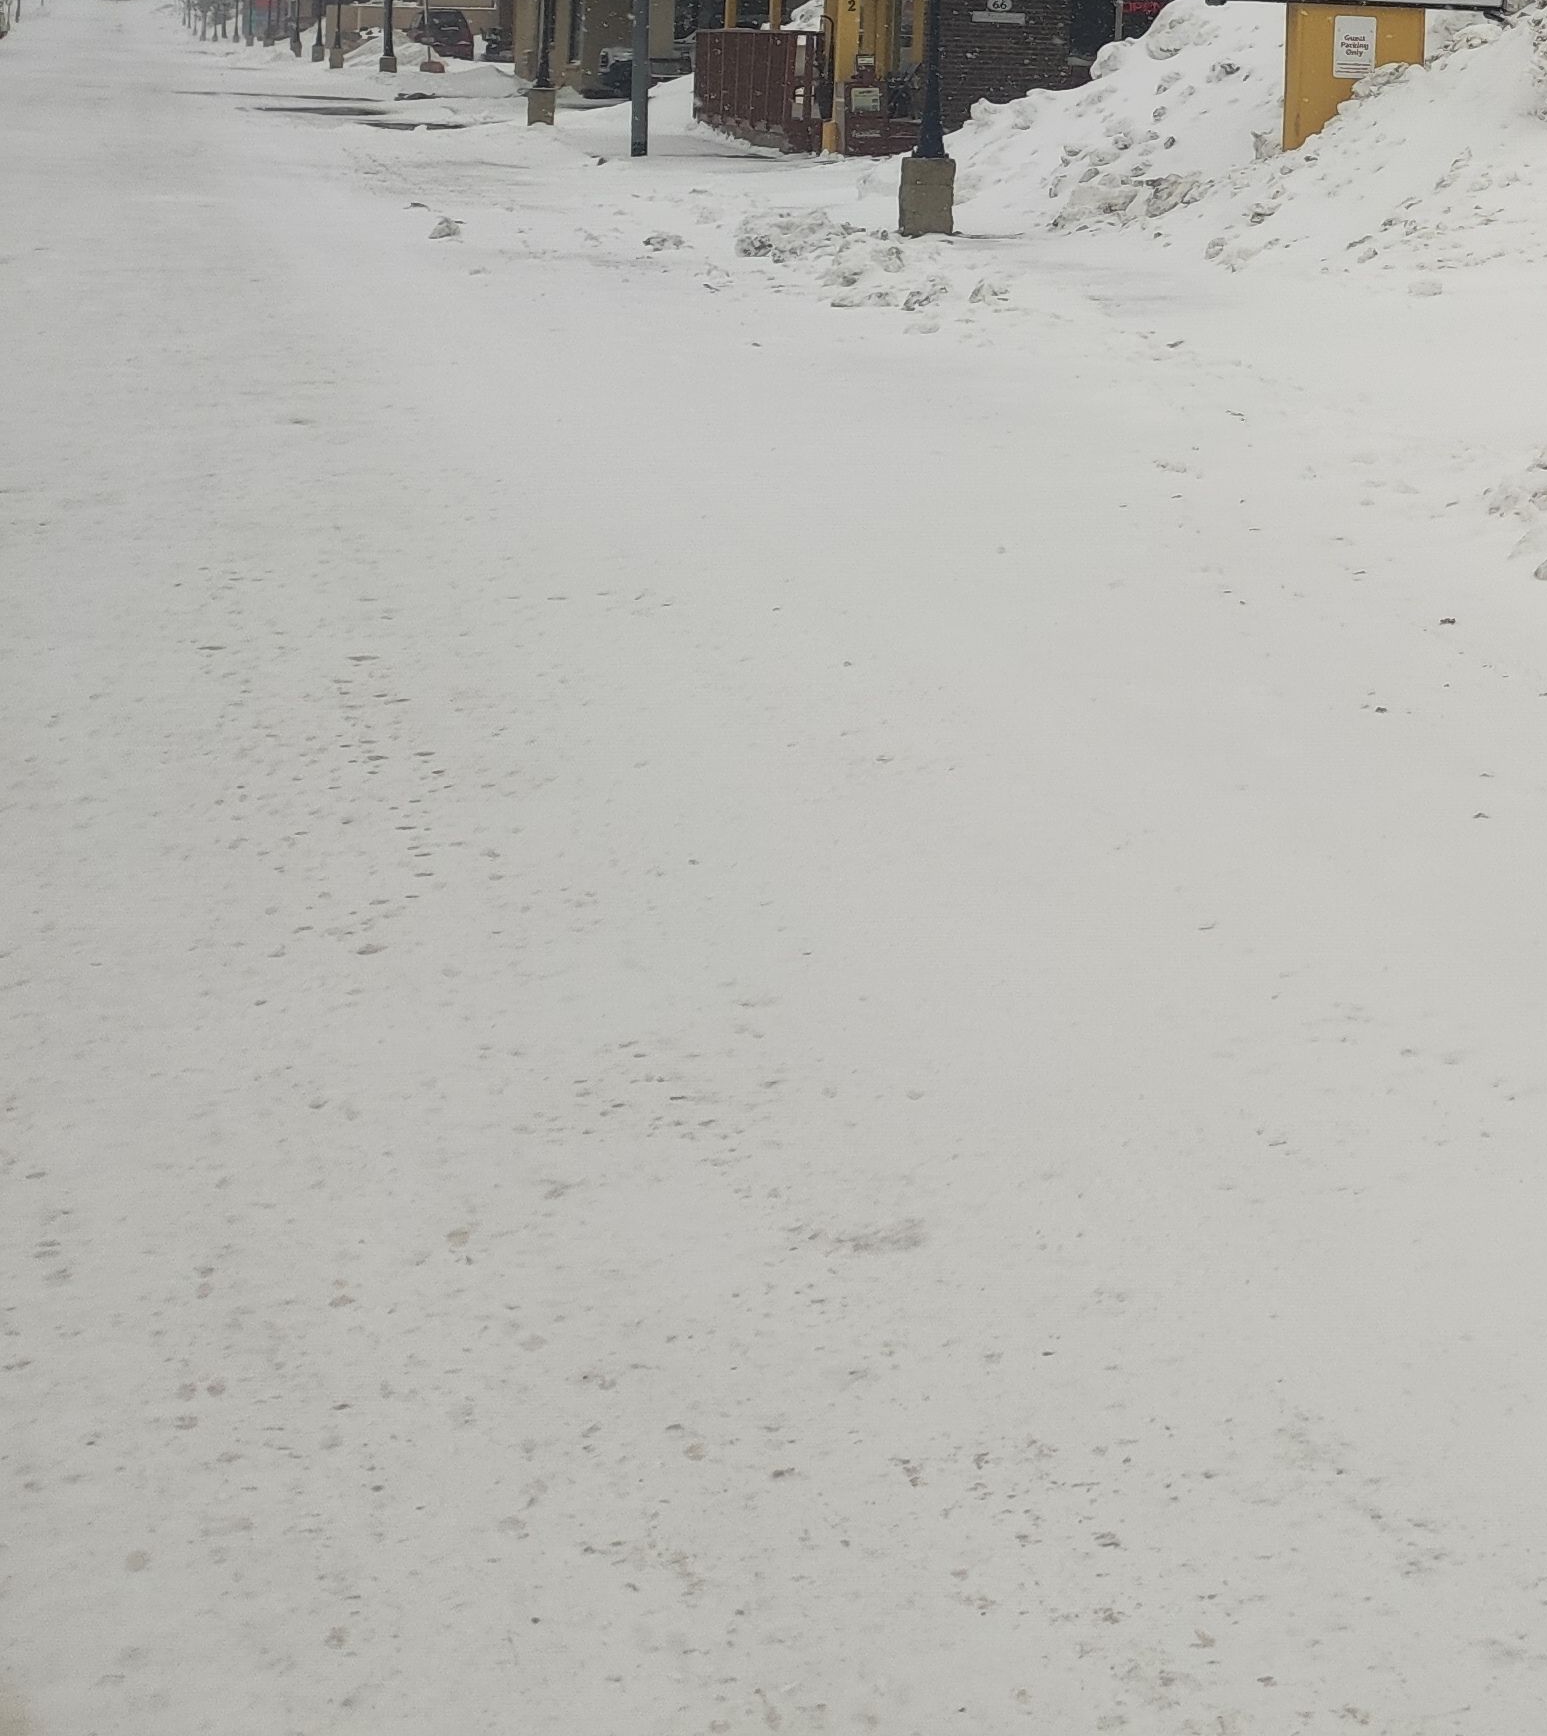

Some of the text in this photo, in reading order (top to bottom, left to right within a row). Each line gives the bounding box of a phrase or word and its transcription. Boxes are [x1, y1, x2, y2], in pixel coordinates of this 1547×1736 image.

[992, 0, 1008, 9] 66
[1344, 34, 1365, 42] Guest
[1341, 41, 1369, 51] Parking
[1345, 49, 1364, 57] Only
